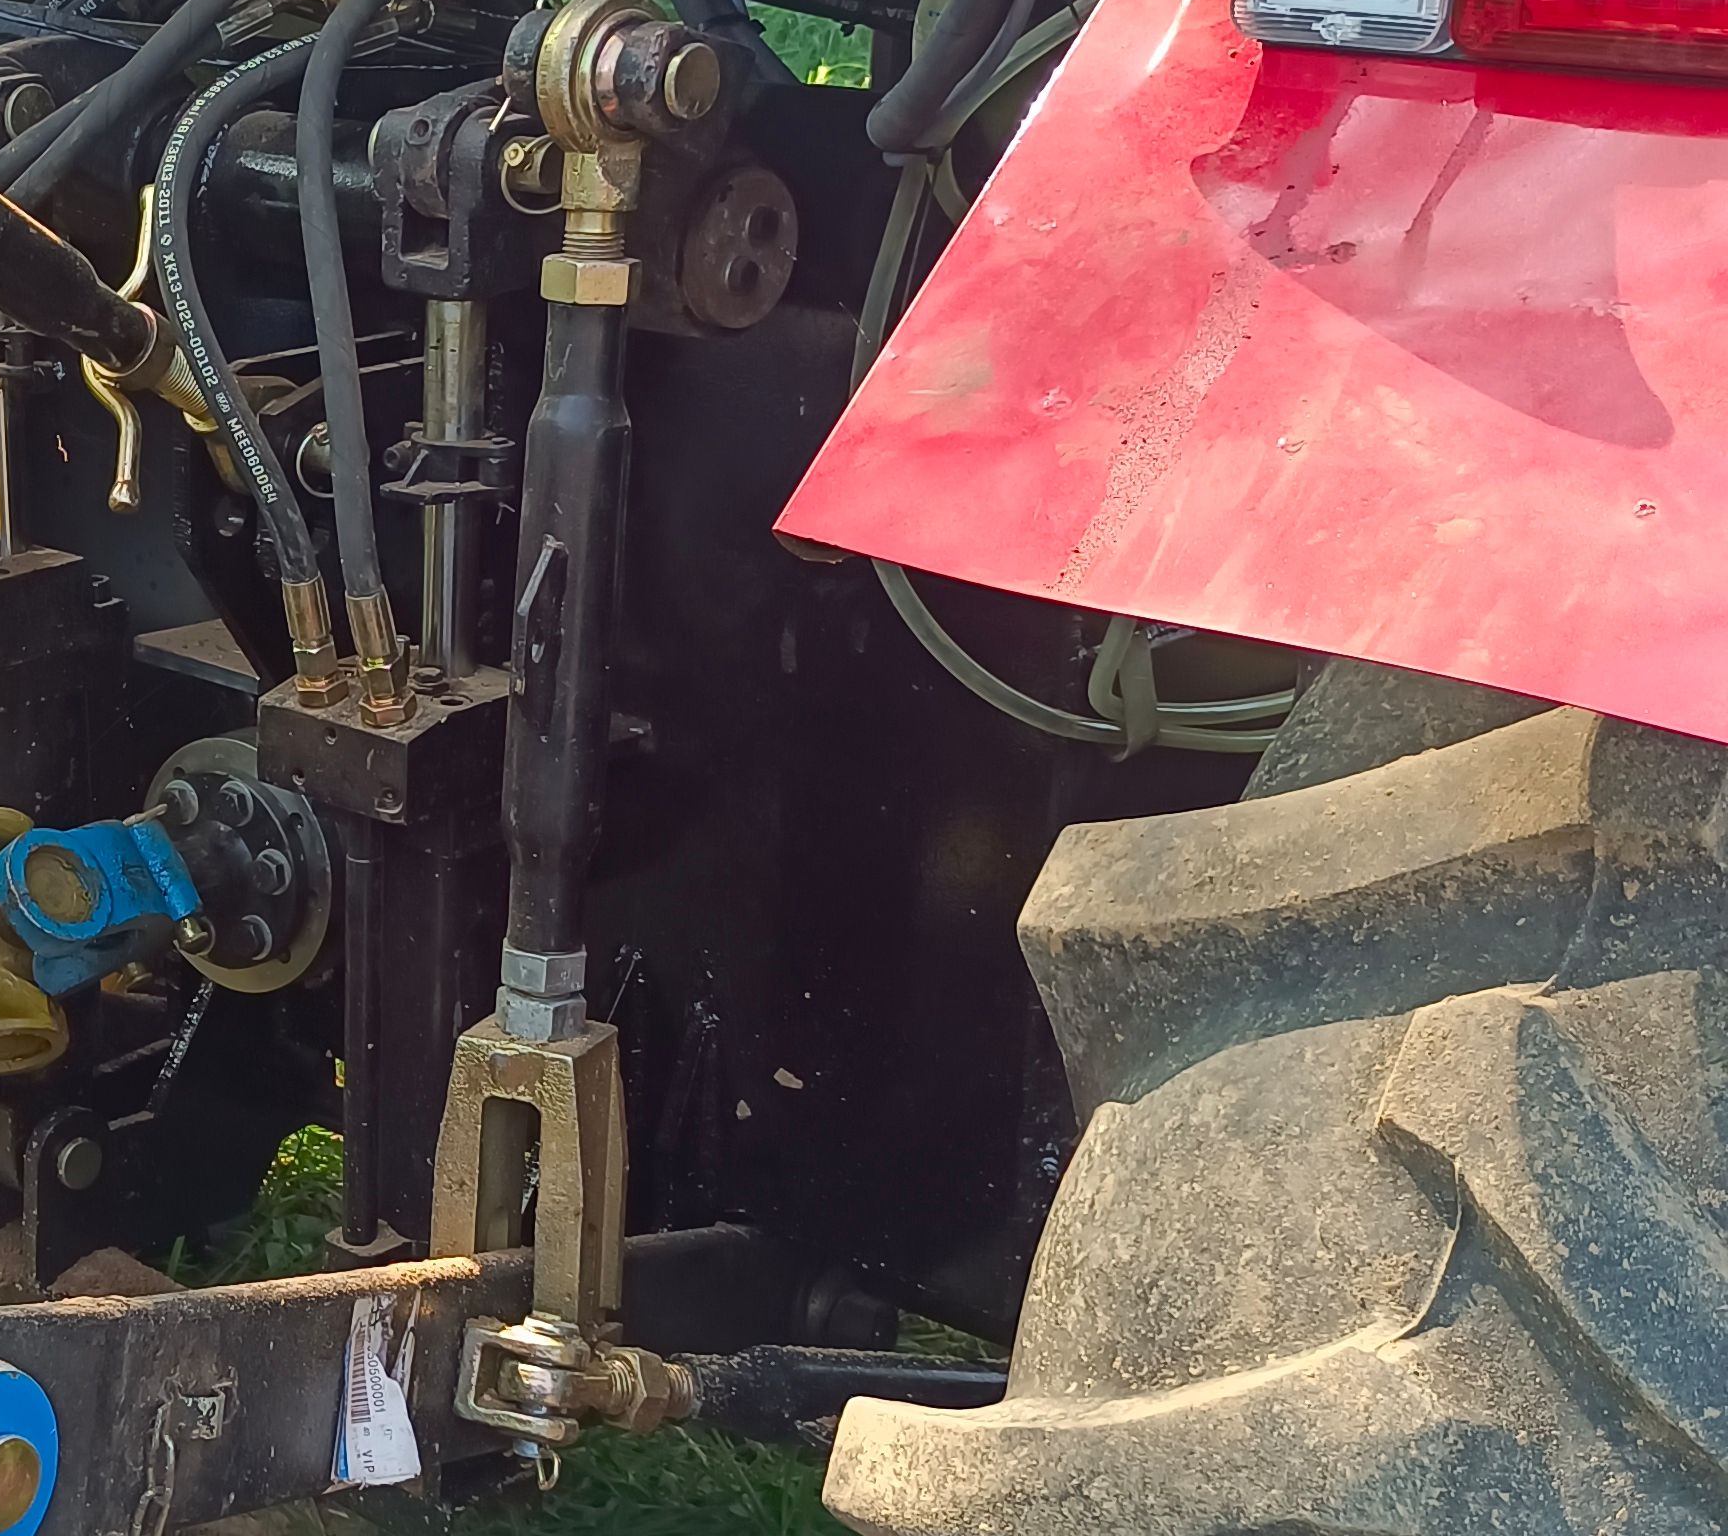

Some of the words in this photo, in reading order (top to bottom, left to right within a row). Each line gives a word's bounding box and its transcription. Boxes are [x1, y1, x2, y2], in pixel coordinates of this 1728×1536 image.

[162, 252, 220, 389] XK13-022-00102
[226, 417, 279, 505] MEE060064
[362, 1449, 376, 1474] VIP
